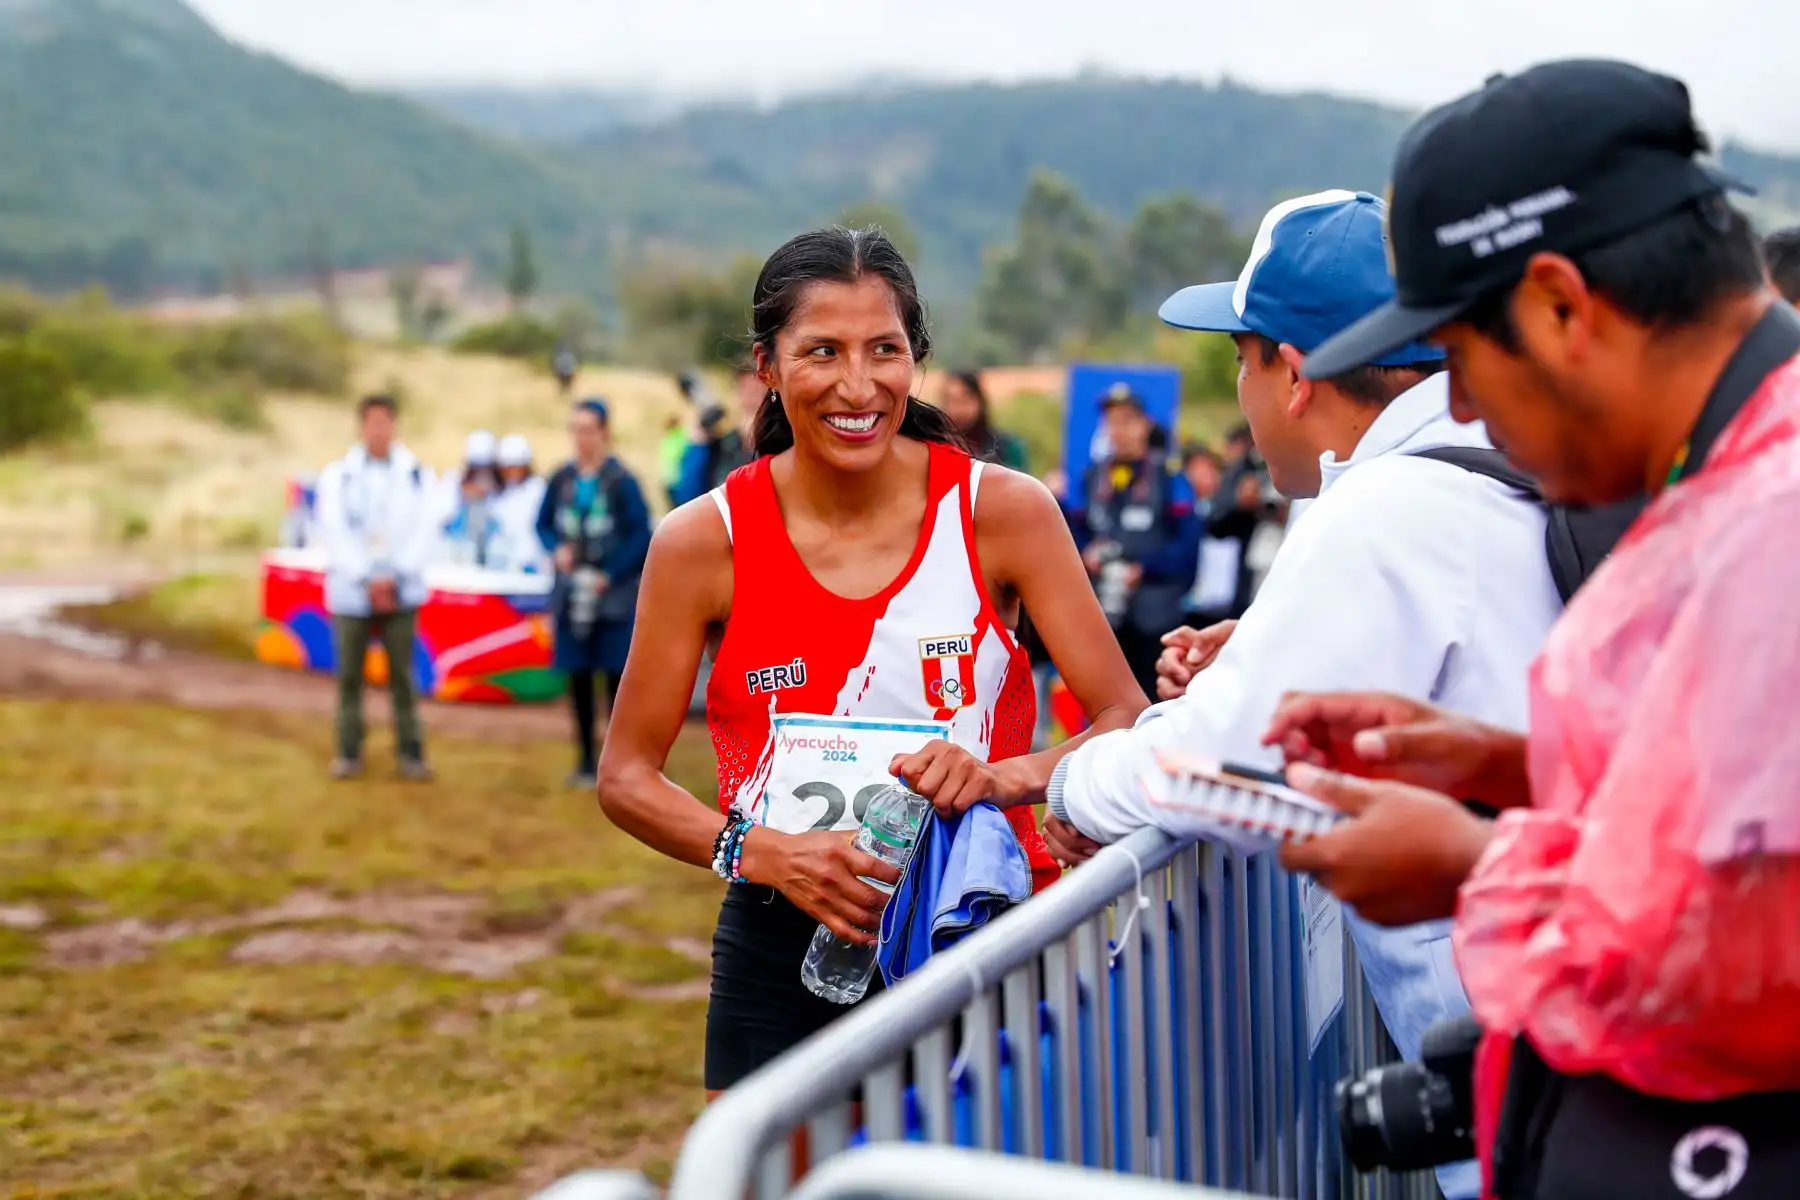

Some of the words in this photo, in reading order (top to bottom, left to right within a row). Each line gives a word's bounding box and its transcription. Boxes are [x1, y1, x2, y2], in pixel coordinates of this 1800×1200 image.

[925, 636, 968, 656] PERÚ
[746, 657, 806, 695] PERÚ
[778, 732, 858, 754] Ayacucho
[822, 749, 858, 762] 2024
